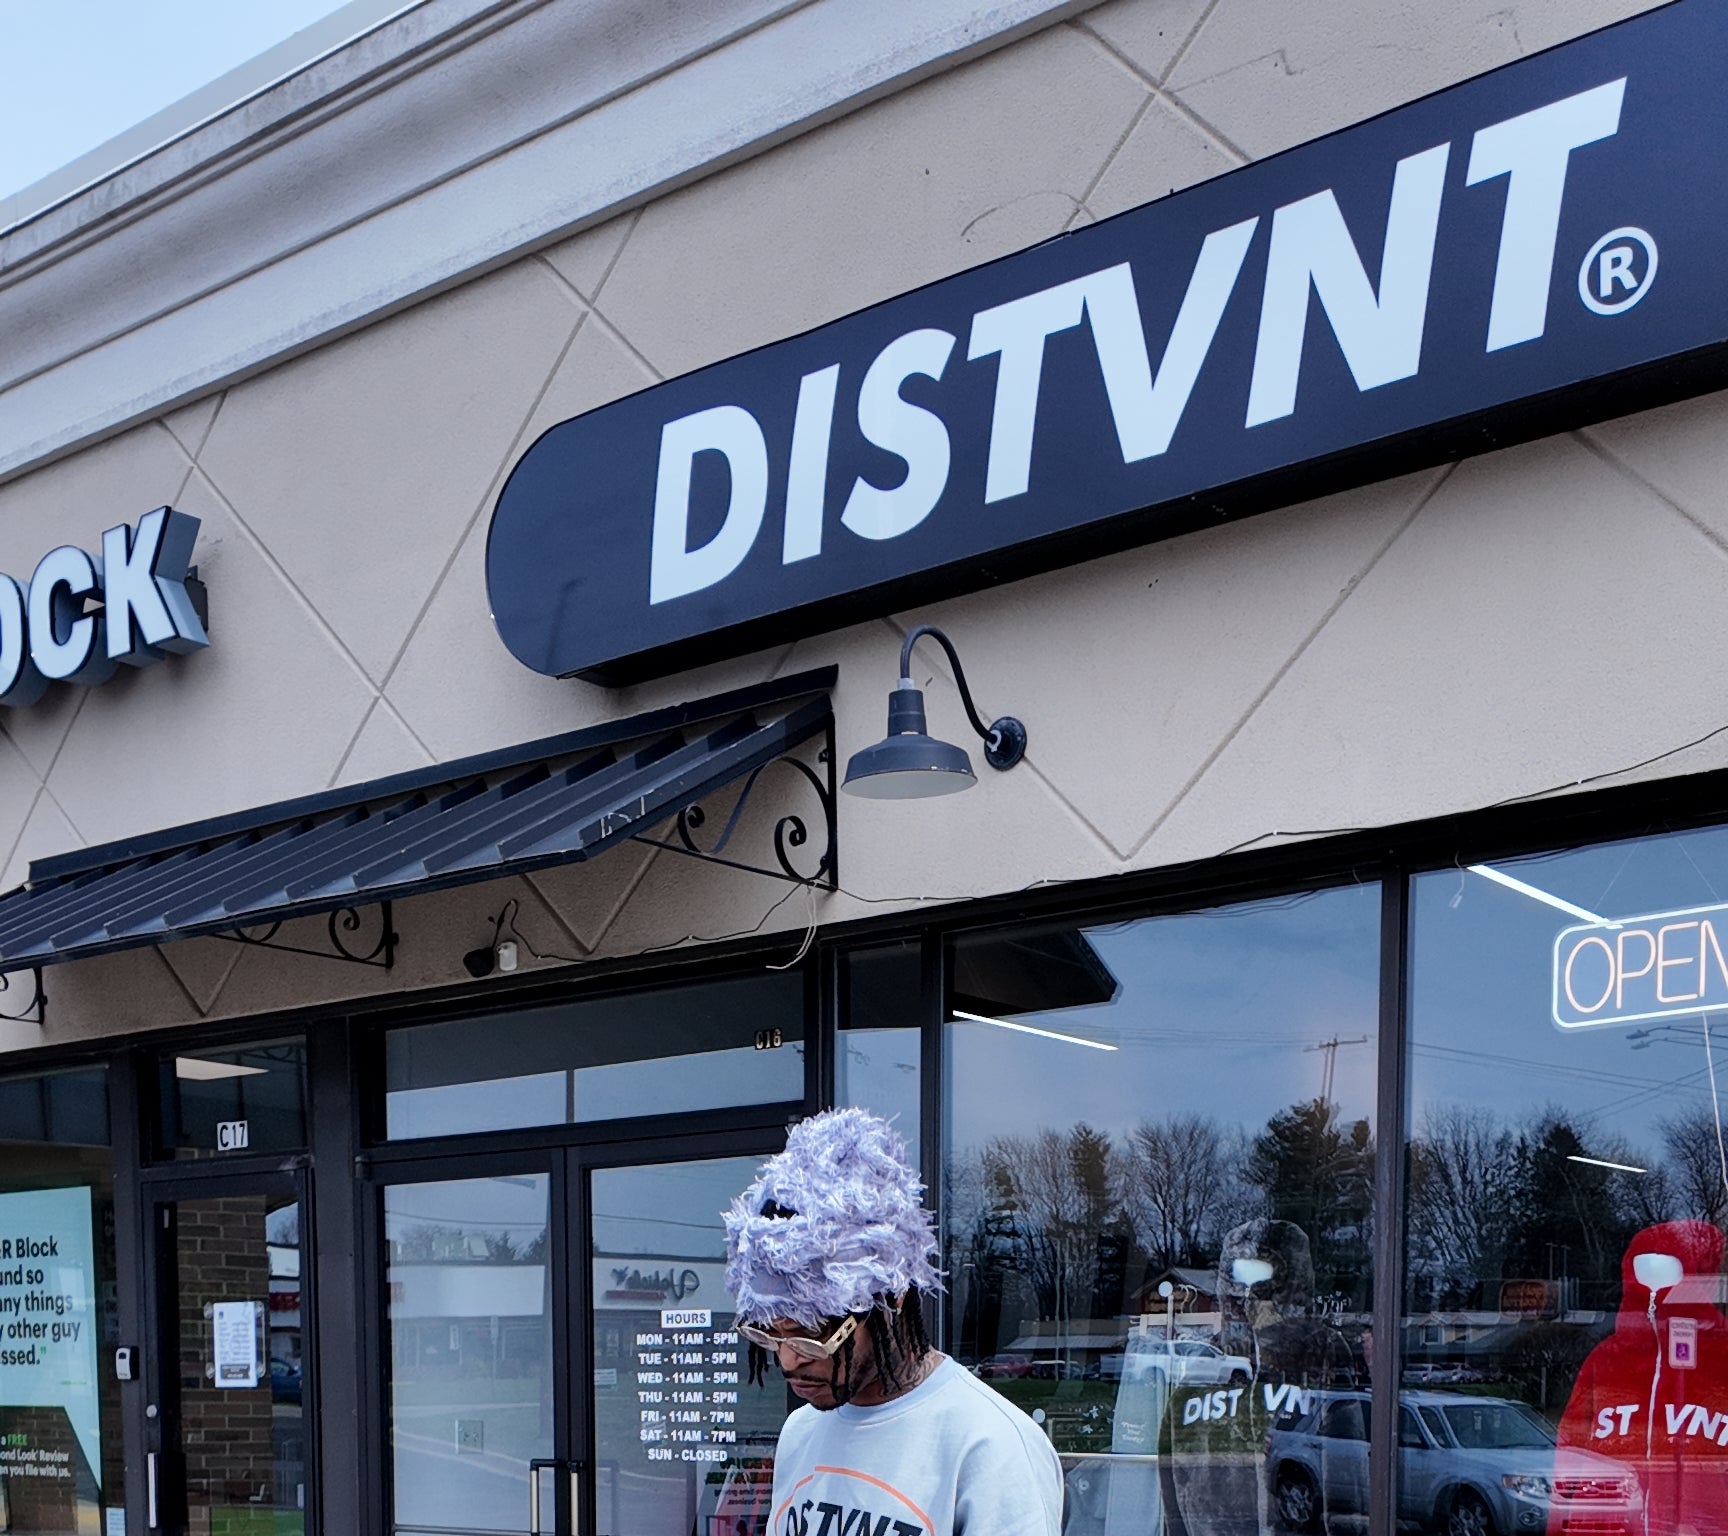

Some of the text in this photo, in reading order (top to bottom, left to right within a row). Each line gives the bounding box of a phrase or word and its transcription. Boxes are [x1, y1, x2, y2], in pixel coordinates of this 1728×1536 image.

[756, 1028, 781, 1050] C16
[220, 1123, 245, 1148] C17
[0, 1235, 58, 1259] R Block
[26, 1269, 44, 1284] so
[25, 1290, 73, 1315] things
[666, 1313, 706, 1324] HOURS
[8, 1317, 48, 1339] other
[52, 1322, 80, 1342] guy
[637, 1333, 662, 1345] MON
[672, 1333, 703, 1345] 11AM
[713, 1332, 738, 1344] 5PM
[638, 1353, 661, 1365] TUE
[671, 1352, 702, 1364] 11AM
[711, 1352, 736, 1364] 5PM
[637, 1372, 662, 1384] WED
[672, 1372, 703, 1384] 11AM
[713, 1372, 738, 1384] 5PM
[638, 1391, 662, 1403] THU
[671, 1391, 703, 1403] 11AM
[712, 1391, 737, 1403] 5PM
[1182, 1388, 1243, 1426] DIST
[641, 1410, 660, 1422] FRI
[669, 1410, 700, 1422] 11AM
[710, 1411, 735, 1423] 7PM
[1595, 1404, 1640, 1439] ST
[8, 1434, 28, 1446] FREE
[640, 1429, 661, 1441] SAT
[670, 1429, 701, 1441] 11AM
[711, 1430, 736, 1442] 7PM
[40, 1449, 69, 1462] Review
[648, 1448, 672, 1460] SUN
[682, 1449, 728, 1461] CLOSED
[10, 1466, 24, 1477] you
[26, 1464, 38, 1475] file
[40, 1464, 57, 1476] with
